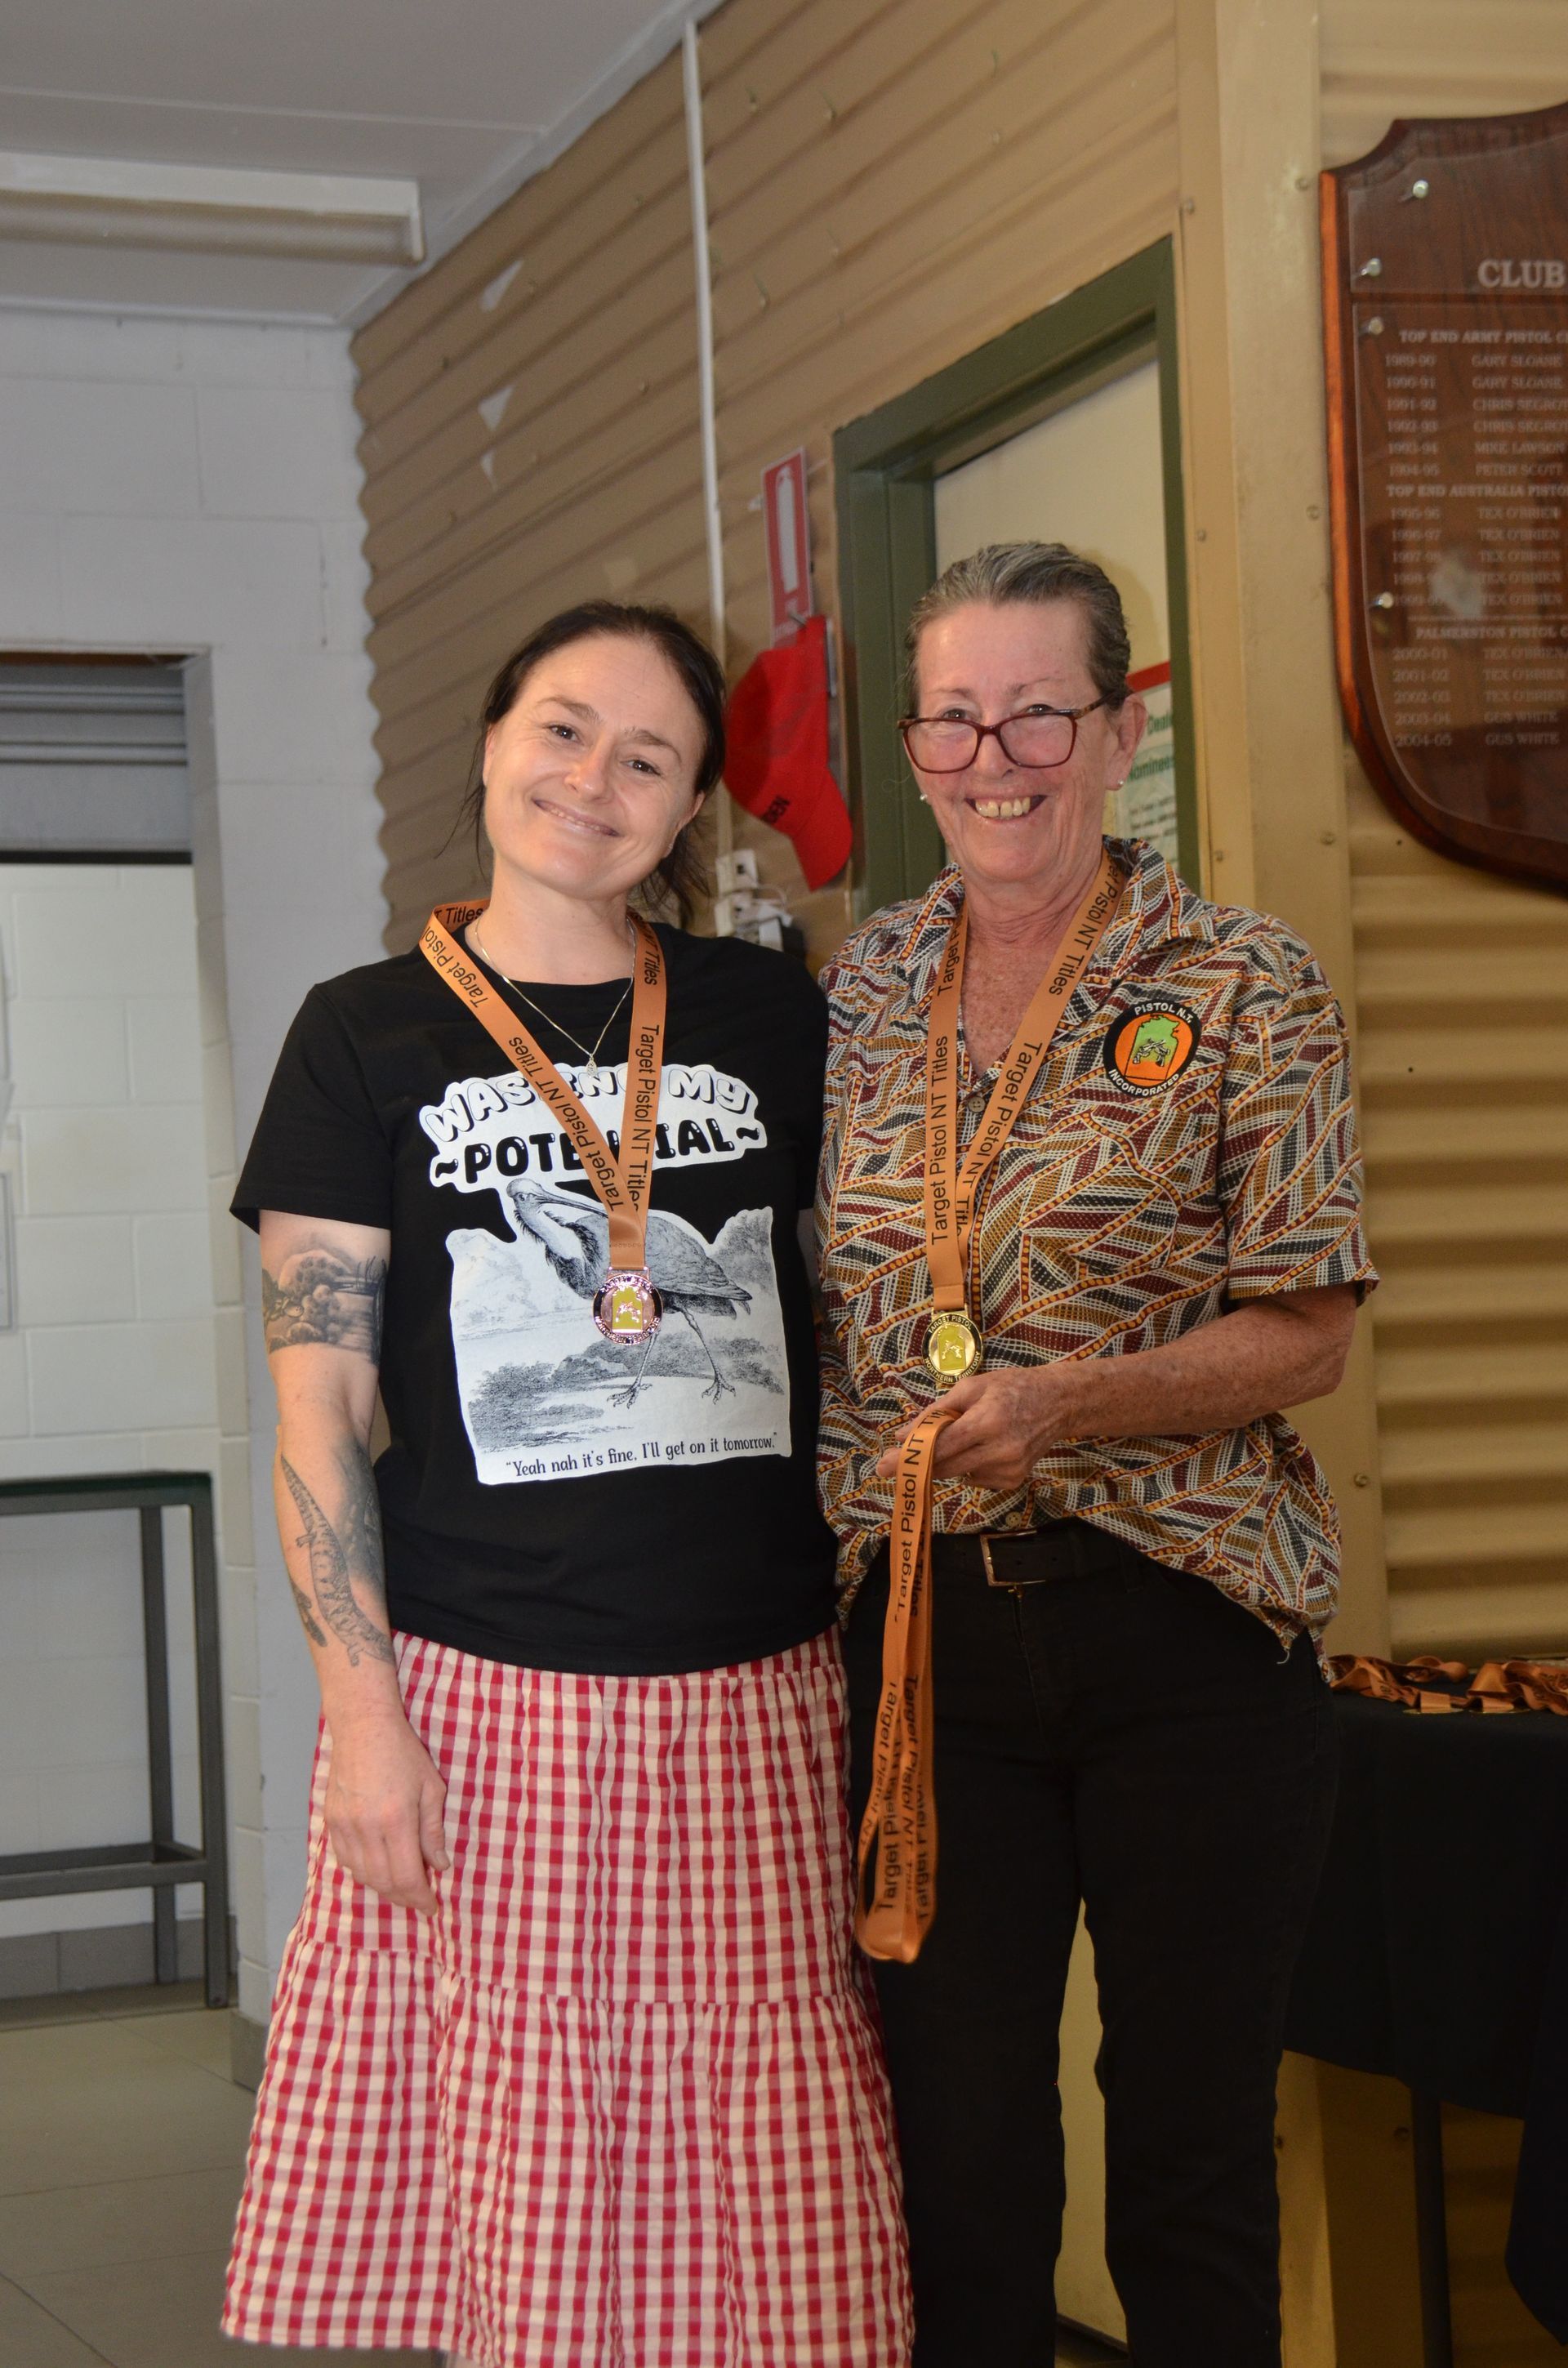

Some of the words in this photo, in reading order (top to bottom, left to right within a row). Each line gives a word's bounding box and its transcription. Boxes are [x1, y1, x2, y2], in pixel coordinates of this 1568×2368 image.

[1477, 260, 1566, 288] CLUB
[1399, 330, 1428, 343] TOP
[1430, 330, 1460, 343] END
[1461, 330, 1502, 343] ARMY
[1505, 330, 1552, 343] PISTOL
[1471, 354, 1508, 368] GARY
[1472, 376, 1508, 389] GARY
[1472, 398, 1514, 412] CHRIS
[1473, 420, 1515, 433] CHRIS
[1475, 442, 1508, 455] MIKE
[1476, 463, 1517, 476] PETER
[1520, 463, 1563, 476] SCOTT
[1386, 484, 1415, 497] TOP
[1418, 484, 1446, 497] END
[1449, 484, 1525, 497] AUSTRALIA
[1477, 507, 1504, 520] TEX
[1479, 528, 1504, 542] TEX
[1480, 551, 1505, 563] TEX
[1416, 627, 1507, 640] PALMERSTON
[1509, 627, 1557, 640] PISTOL
[1483, 647, 1508, 659] TEX
[1483, 668, 1510, 681] TEX
[1086, 881, 1117, 925] Pistol
[421, 926, 454, 967] Pistol
[1074, 923, 1098, 950] NT
[644, 950, 660, 986] Titles
[937, 940, 960, 997] Target
[1049, 954, 1085, 996] Titles
[447, 962, 488, 1008] Target
[1134, 1002, 1175, 1015] PISTOL
[1176, 1007, 1193, 1023] N.T.
[509, 1037, 543, 1077] Titles
[635, 1024, 660, 1073] Target
[931, 1036, 948, 1085] Titles
[1001, 1042, 1043, 1103] Target
[1108, 1068, 1179, 1096] INCORPORATED
[535, 1080, 565, 1101] NT
[635, 1078, 657, 1122] Pistol
[668, 1069, 751, 1114] MY
[931, 1094, 947, 1119] NT
[555, 1103, 595, 1148] Pistol
[977, 1106, 1013, 1157] Pistol
[465, 1118, 735, 1184] POTEIAL
[631, 1127, 652, 1154] NT
[929, 1124, 947, 1174] Pistol
[586, 1150, 624, 1212] Target
[962, 1162, 984, 1188] NT
[931, 1180, 951, 1246] Target
[928, 1316, 951, 1334] TARGET
[951, 1316, 972, 1330] PISTOL
[924, 1358, 953, 1383] NORTHERN
[551, 1456, 578, 1473] nah
[583, 1450, 604, 1468] it's
[642, 1442, 660, 1460] I'll
[666, 1441, 685, 1460] get
[689, 1442, 706, 1454] on
[710, 1438, 719, 1452] it
[904, 1434, 924, 1465] NT
[901, 1473, 917, 1533] Pistol
[898, 1541, 913, 1612] Target
[874, 1842, 901, 1913] Target
